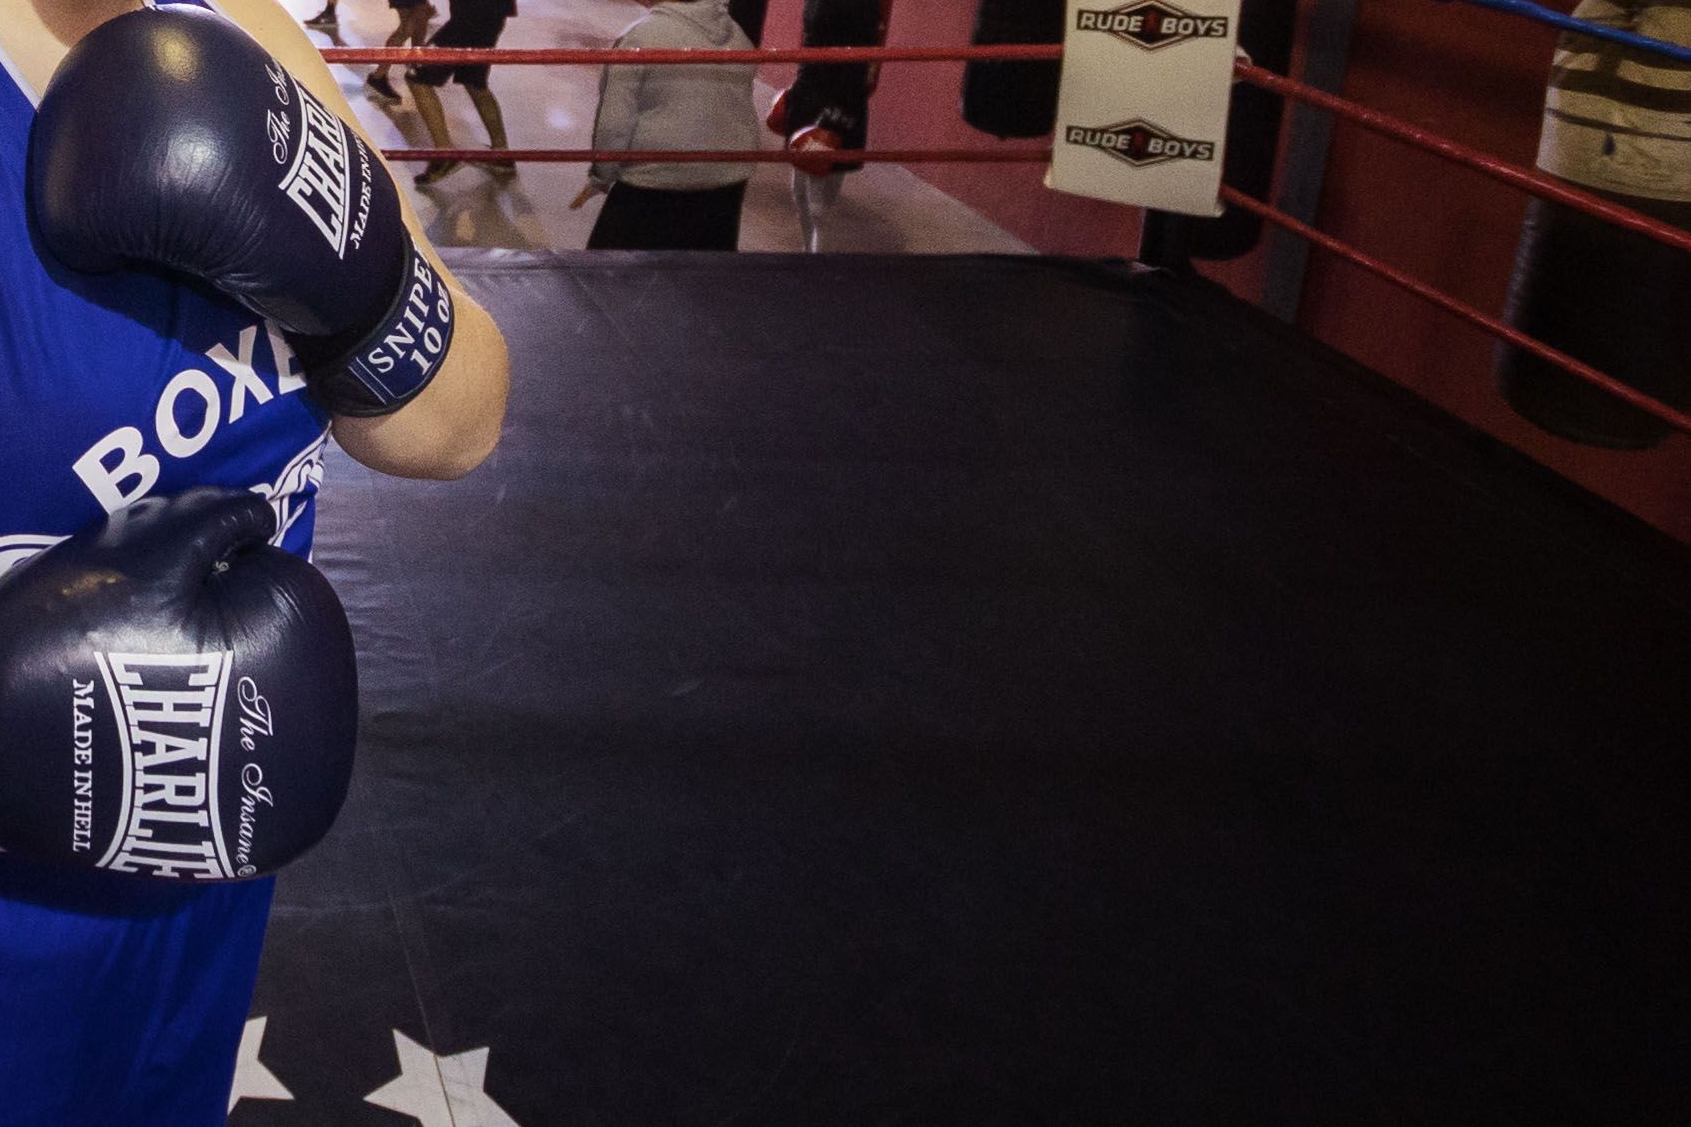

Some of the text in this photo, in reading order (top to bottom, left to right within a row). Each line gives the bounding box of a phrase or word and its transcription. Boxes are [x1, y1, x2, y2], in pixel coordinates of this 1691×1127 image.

[1079, 12, 1227, 37] RUDE BOYS
[267, 109, 291, 164] The
[1068, 128, 1213, 160] RUDE BOYS
[350, 182, 371, 249] MADE
[411, 326, 442, 375] 10
[237, 676, 273, 751] The
[73, 679, 95, 852] MADE IN HELL
[108, 651, 224, 879] CHARLIE
